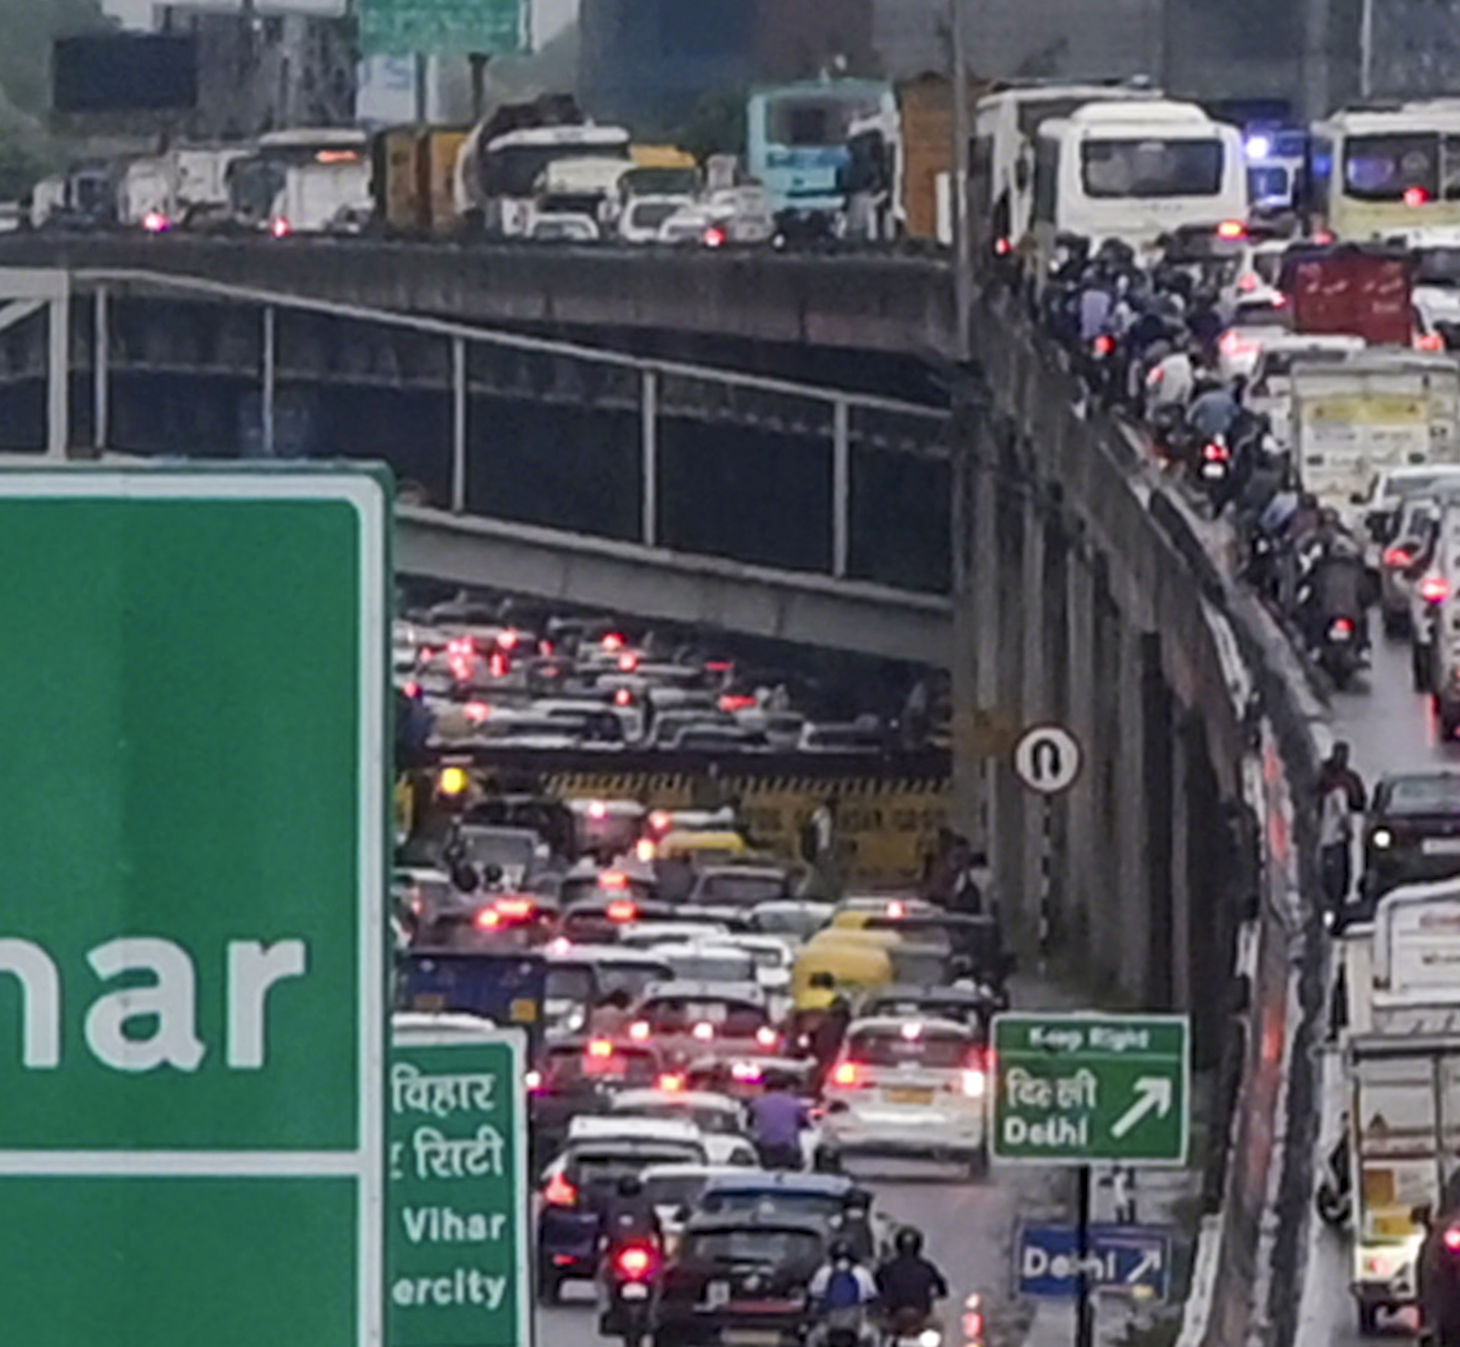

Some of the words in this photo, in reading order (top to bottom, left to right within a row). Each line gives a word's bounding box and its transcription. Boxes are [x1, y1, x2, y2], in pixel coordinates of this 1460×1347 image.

[1089, 1026, 1149, 1052] Right
[1004, 1114, 1088, 1146] Delhi
[402, 1205, 507, 1243] Vihar
